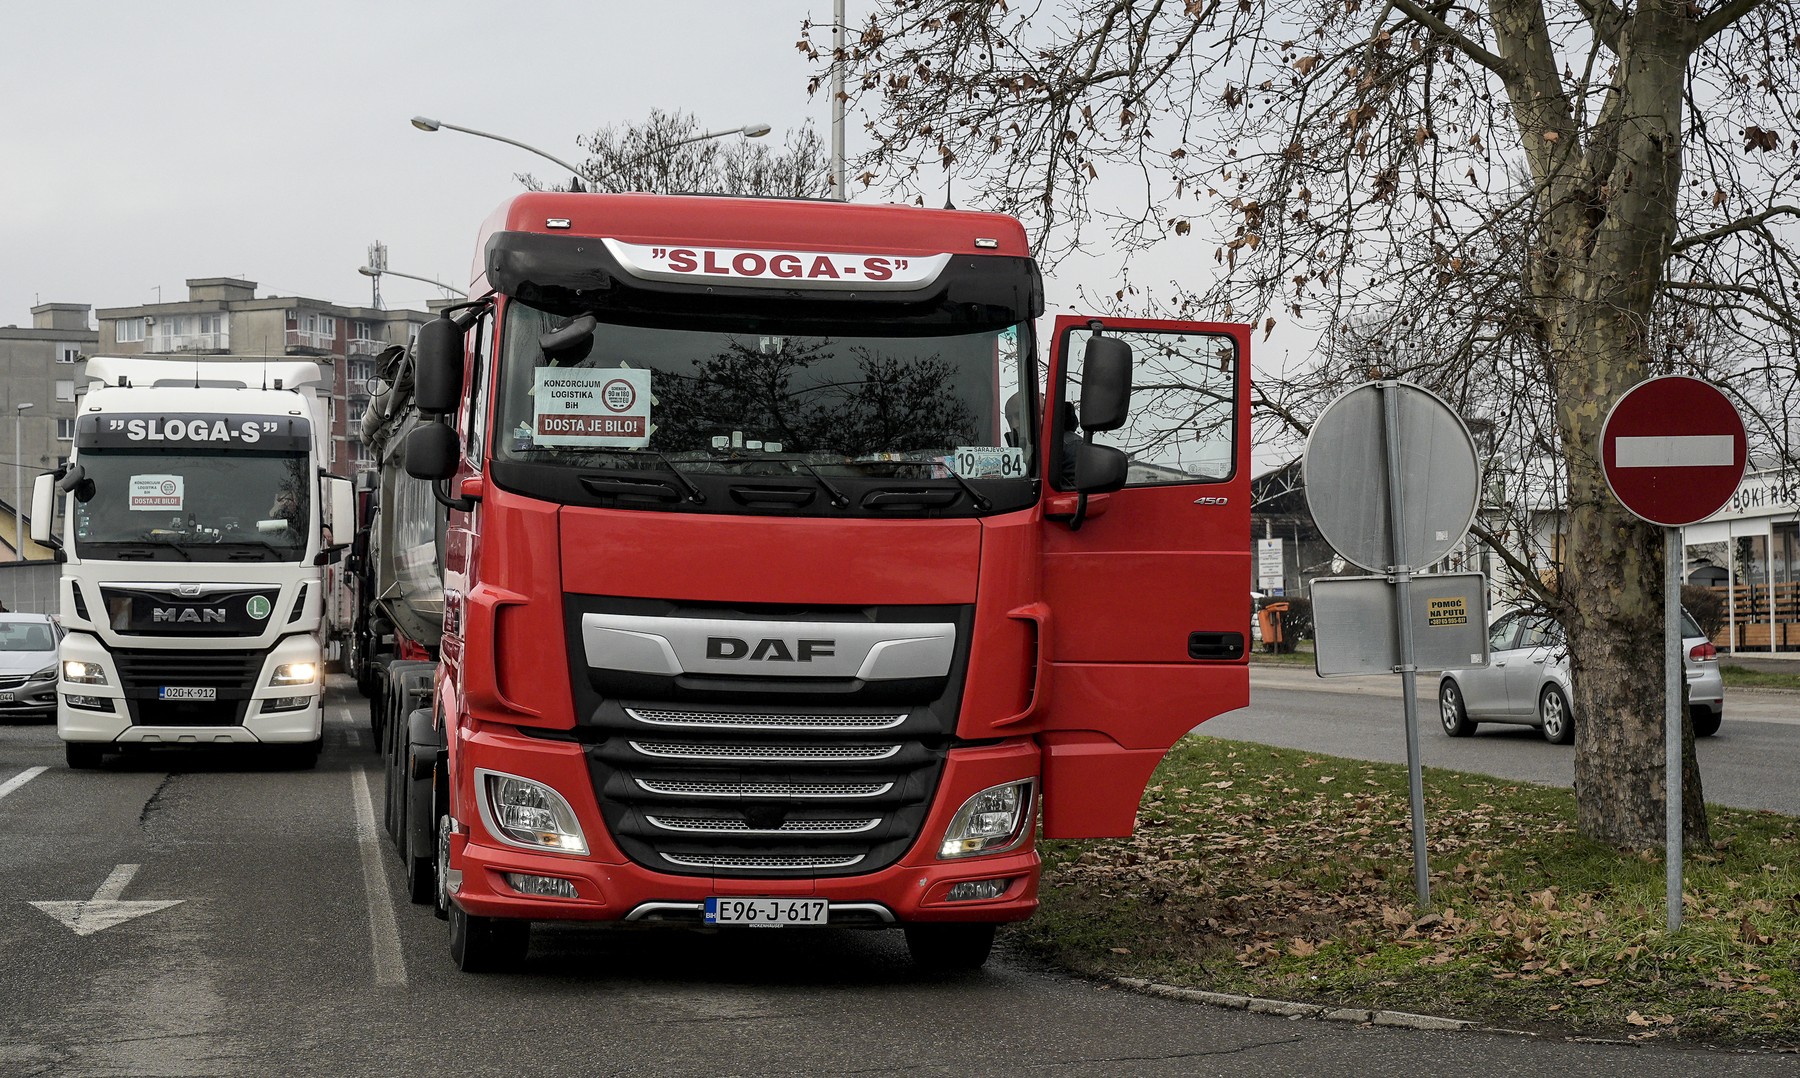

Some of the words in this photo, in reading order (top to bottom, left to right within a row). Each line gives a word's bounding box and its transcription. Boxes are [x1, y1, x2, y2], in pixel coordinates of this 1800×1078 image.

[544, 379, 600, 388] KONZORCIJUM
[551, 390, 593, 399] LOGISTIKA
[621, 390, 630, 398] 180
[565, 401, 578, 409] BiH
[544, 419, 584, 431] DOSTA
[588, 420, 601, 432] JE
[605, 420, 637, 433] BILO!
[958, 453, 975, 475] 19
[1001, 454, 1022, 476] 84
[1193, 497, 1228, 505] 450
[1733, 487, 1764, 509] BOKI
[253, 600, 263, 614] L
[153, 607, 226, 622] MAN
[706, 637, 835, 662] DAF
[720, 901, 824, 921] E96-J-617
